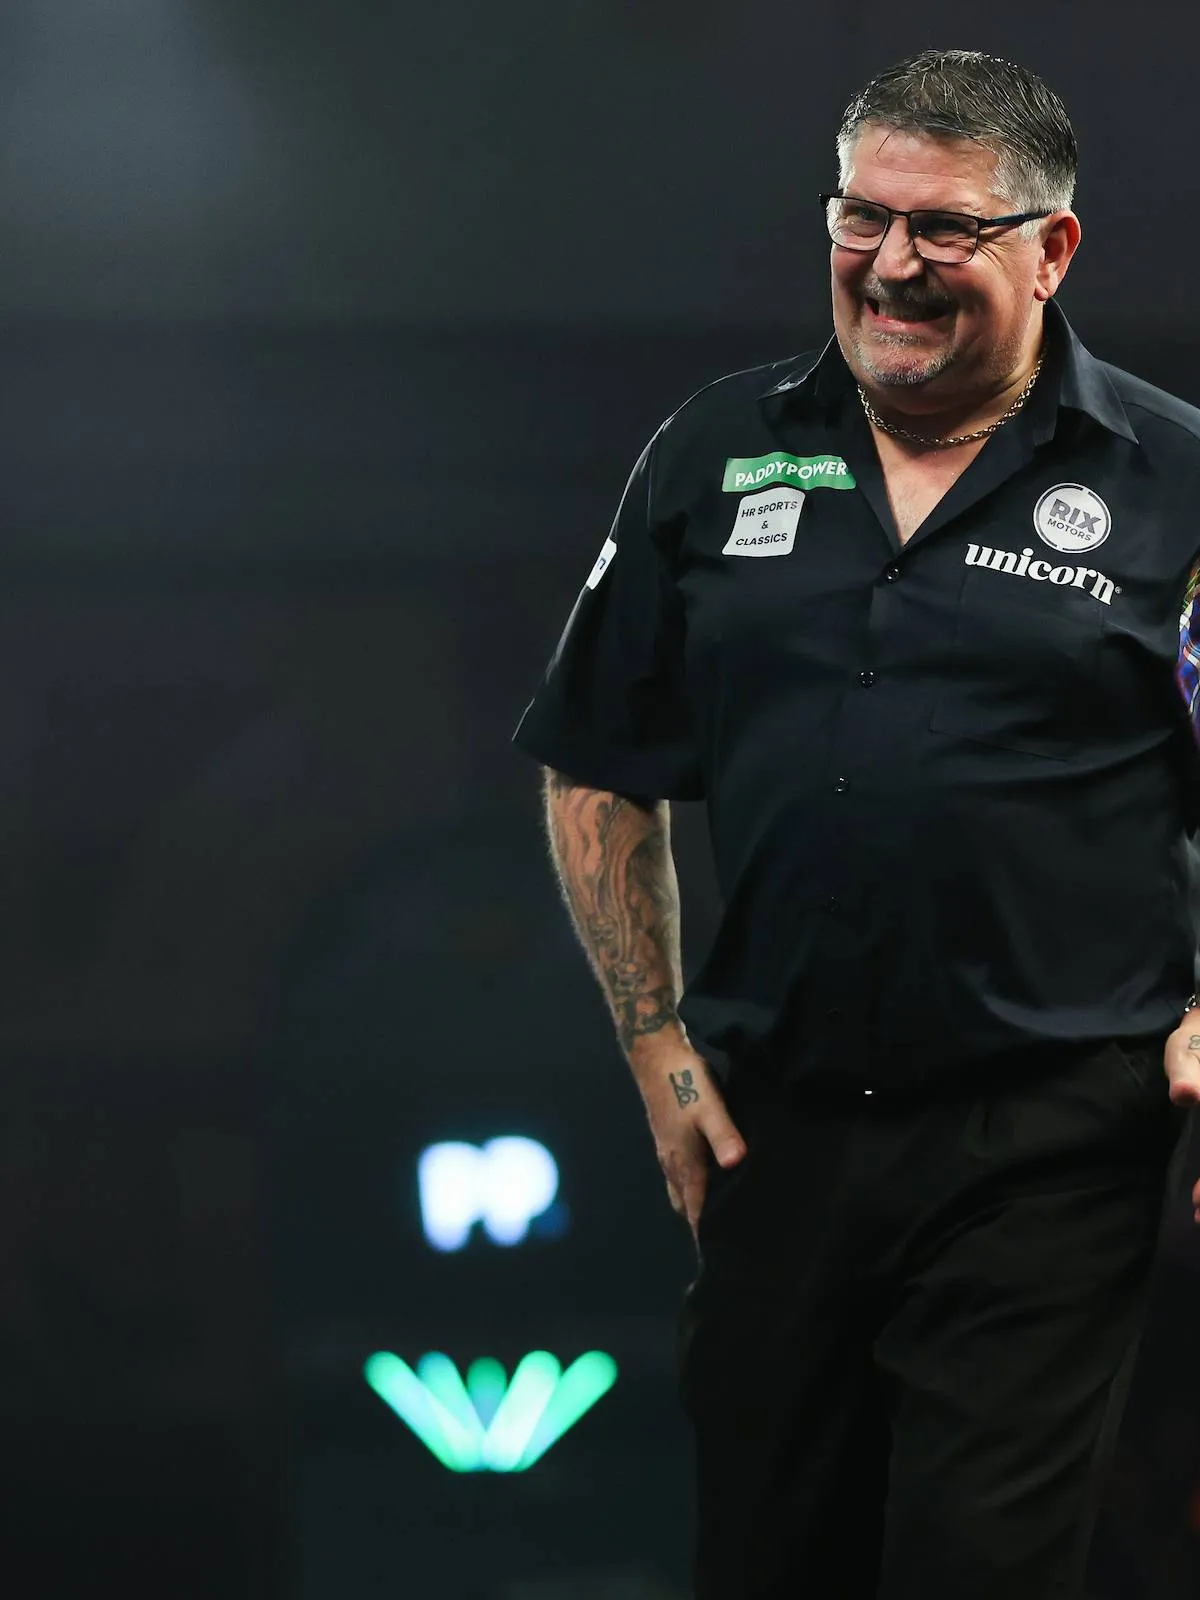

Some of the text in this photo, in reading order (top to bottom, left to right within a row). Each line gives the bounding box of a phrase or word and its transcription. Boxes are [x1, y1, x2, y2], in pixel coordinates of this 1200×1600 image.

[741, 500, 798, 518] HR SPORTS
[1050, 498, 1102, 535] RIX
[761, 520, 769, 530] &
[1047, 518, 1092, 542] MOTORS
[735, 532, 788, 547] CLASSICS
